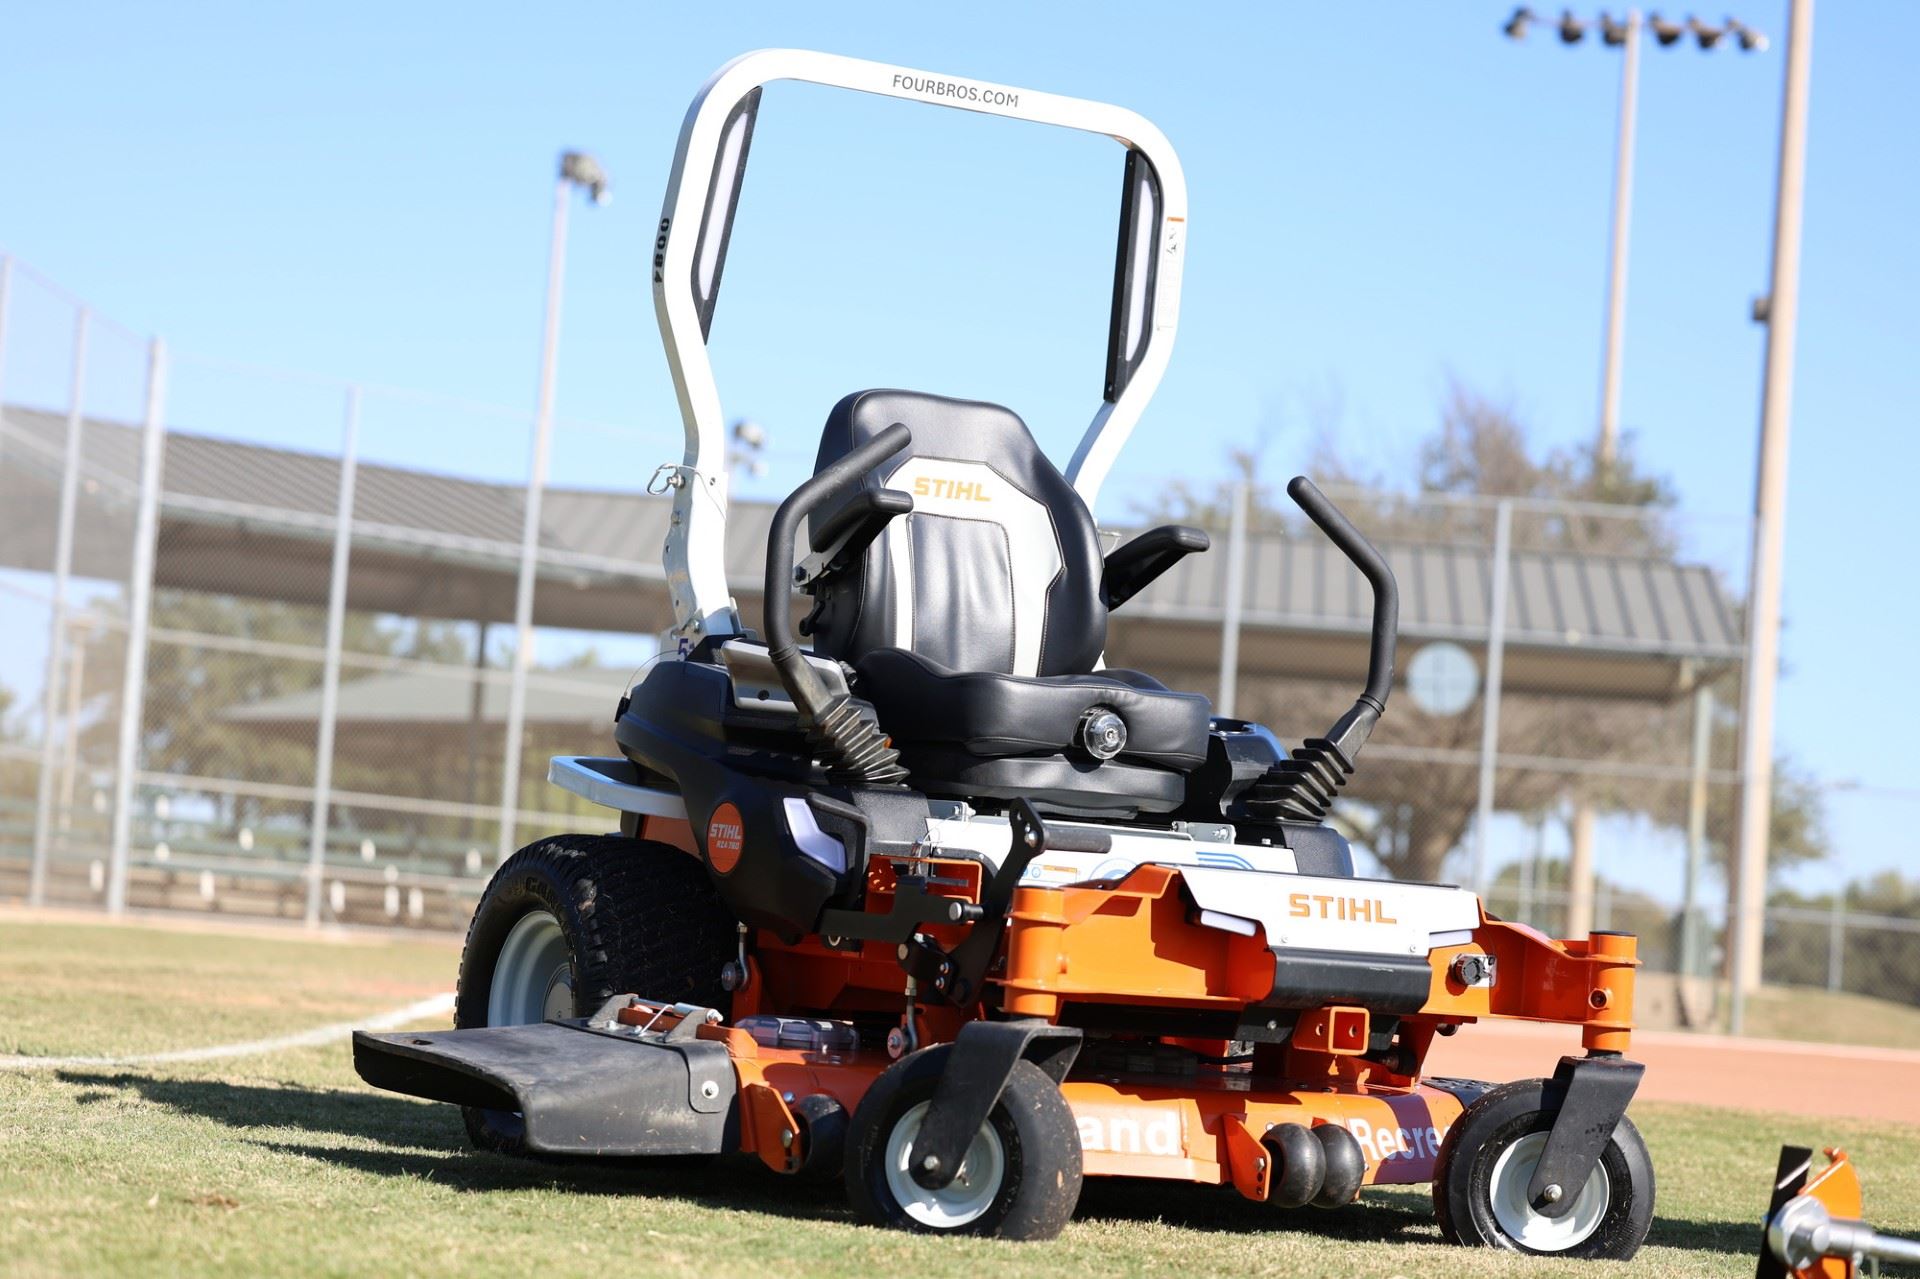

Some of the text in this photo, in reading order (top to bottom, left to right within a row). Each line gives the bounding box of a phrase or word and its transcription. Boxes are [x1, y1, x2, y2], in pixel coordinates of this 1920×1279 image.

[892, 74, 1019, 108] FOURBROS.COM
[654, 217, 670, 283] 0084
[913, 476, 992, 502] STIHL
[709, 823, 742, 841] STIHL
[1289, 893, 1397, 925] STIHL
[1077, 1110, 1178, 1156] and
